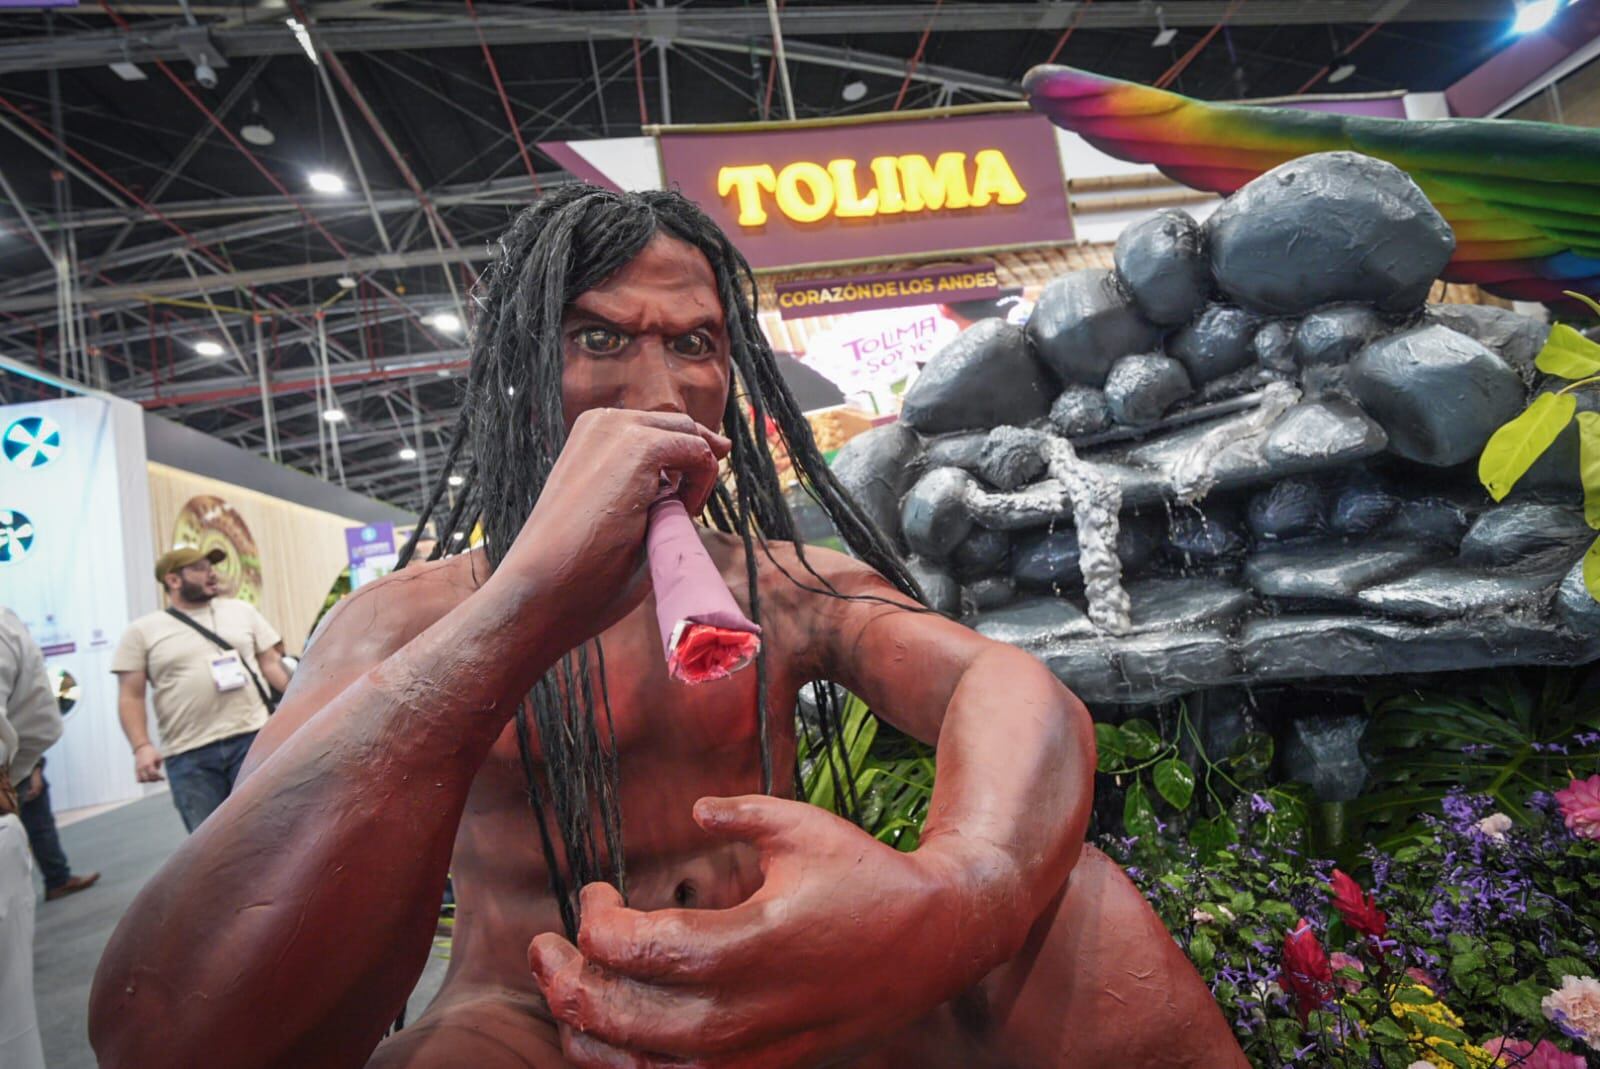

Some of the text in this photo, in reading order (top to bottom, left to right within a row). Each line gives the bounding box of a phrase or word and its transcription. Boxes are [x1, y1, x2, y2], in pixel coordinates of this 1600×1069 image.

[718, 149, 1026, 226] TOLIMA
[779, 271, 998, 308] CORAZÓN DE LOS ANDES
